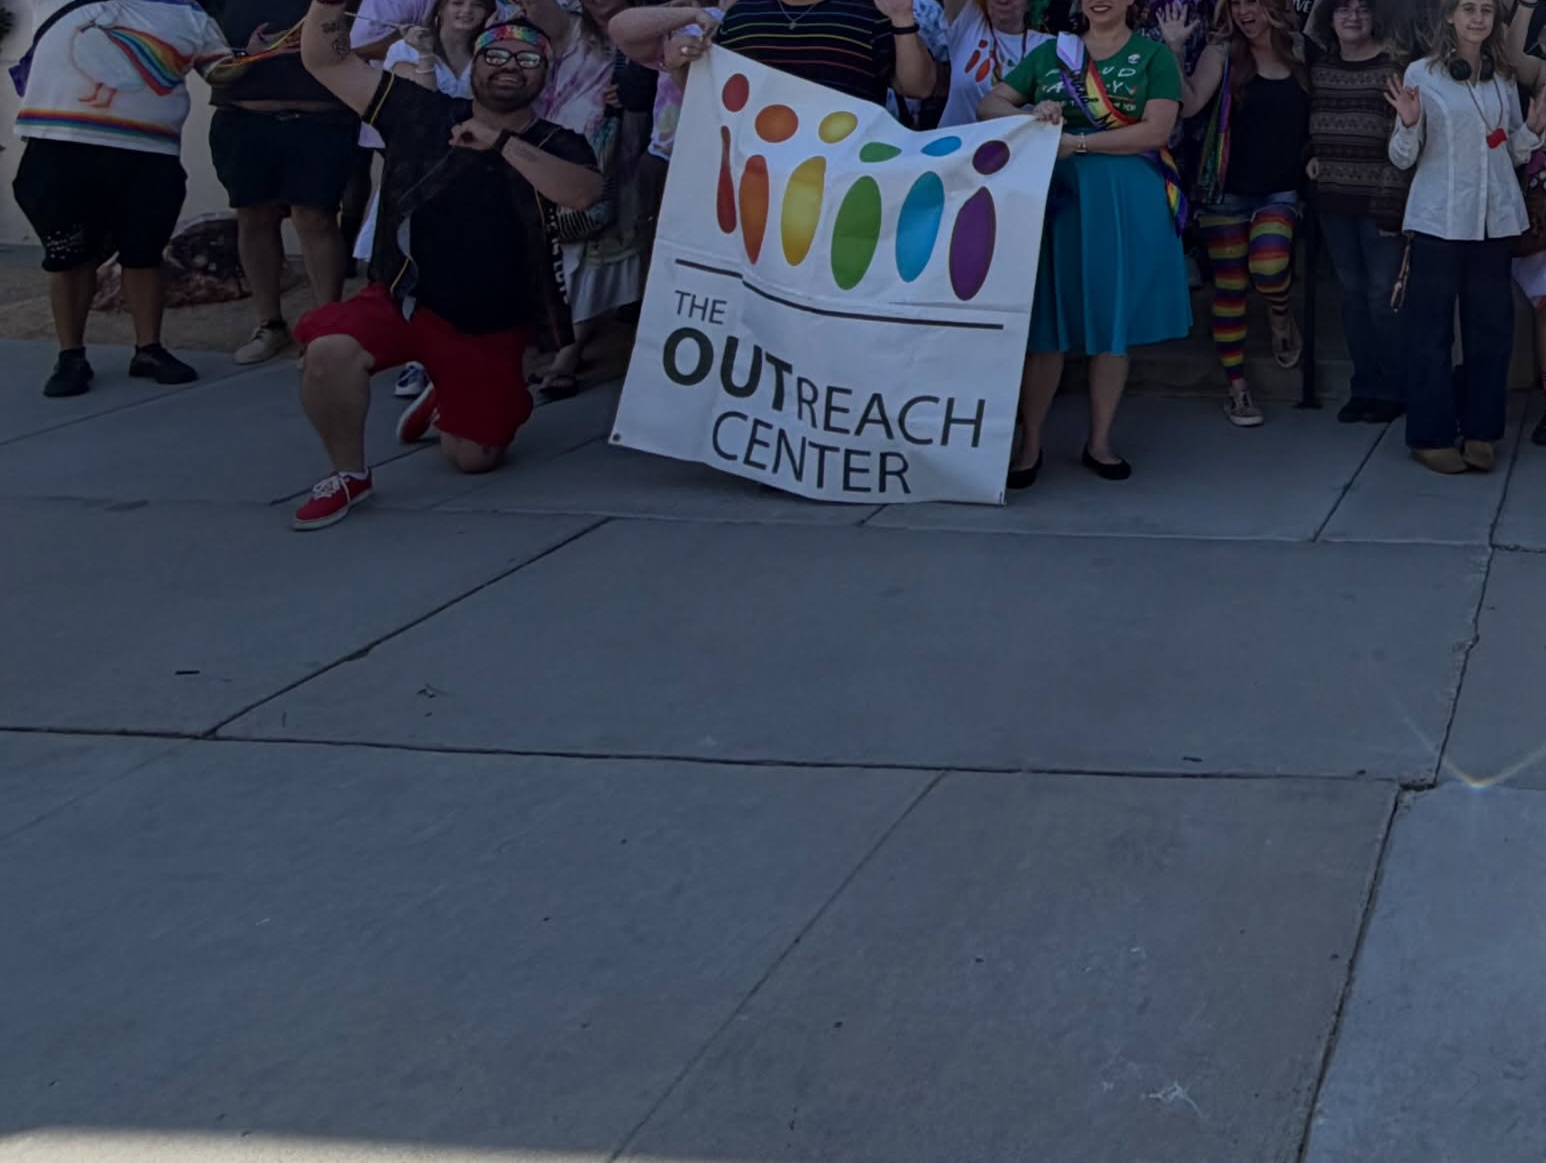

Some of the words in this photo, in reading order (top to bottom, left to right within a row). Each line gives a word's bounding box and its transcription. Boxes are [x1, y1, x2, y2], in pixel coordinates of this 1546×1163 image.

[675, 290, 728, 325] THE
[663, 327, 987, 448] OUTREACH
[712, 411, 912, 495] CENTER
